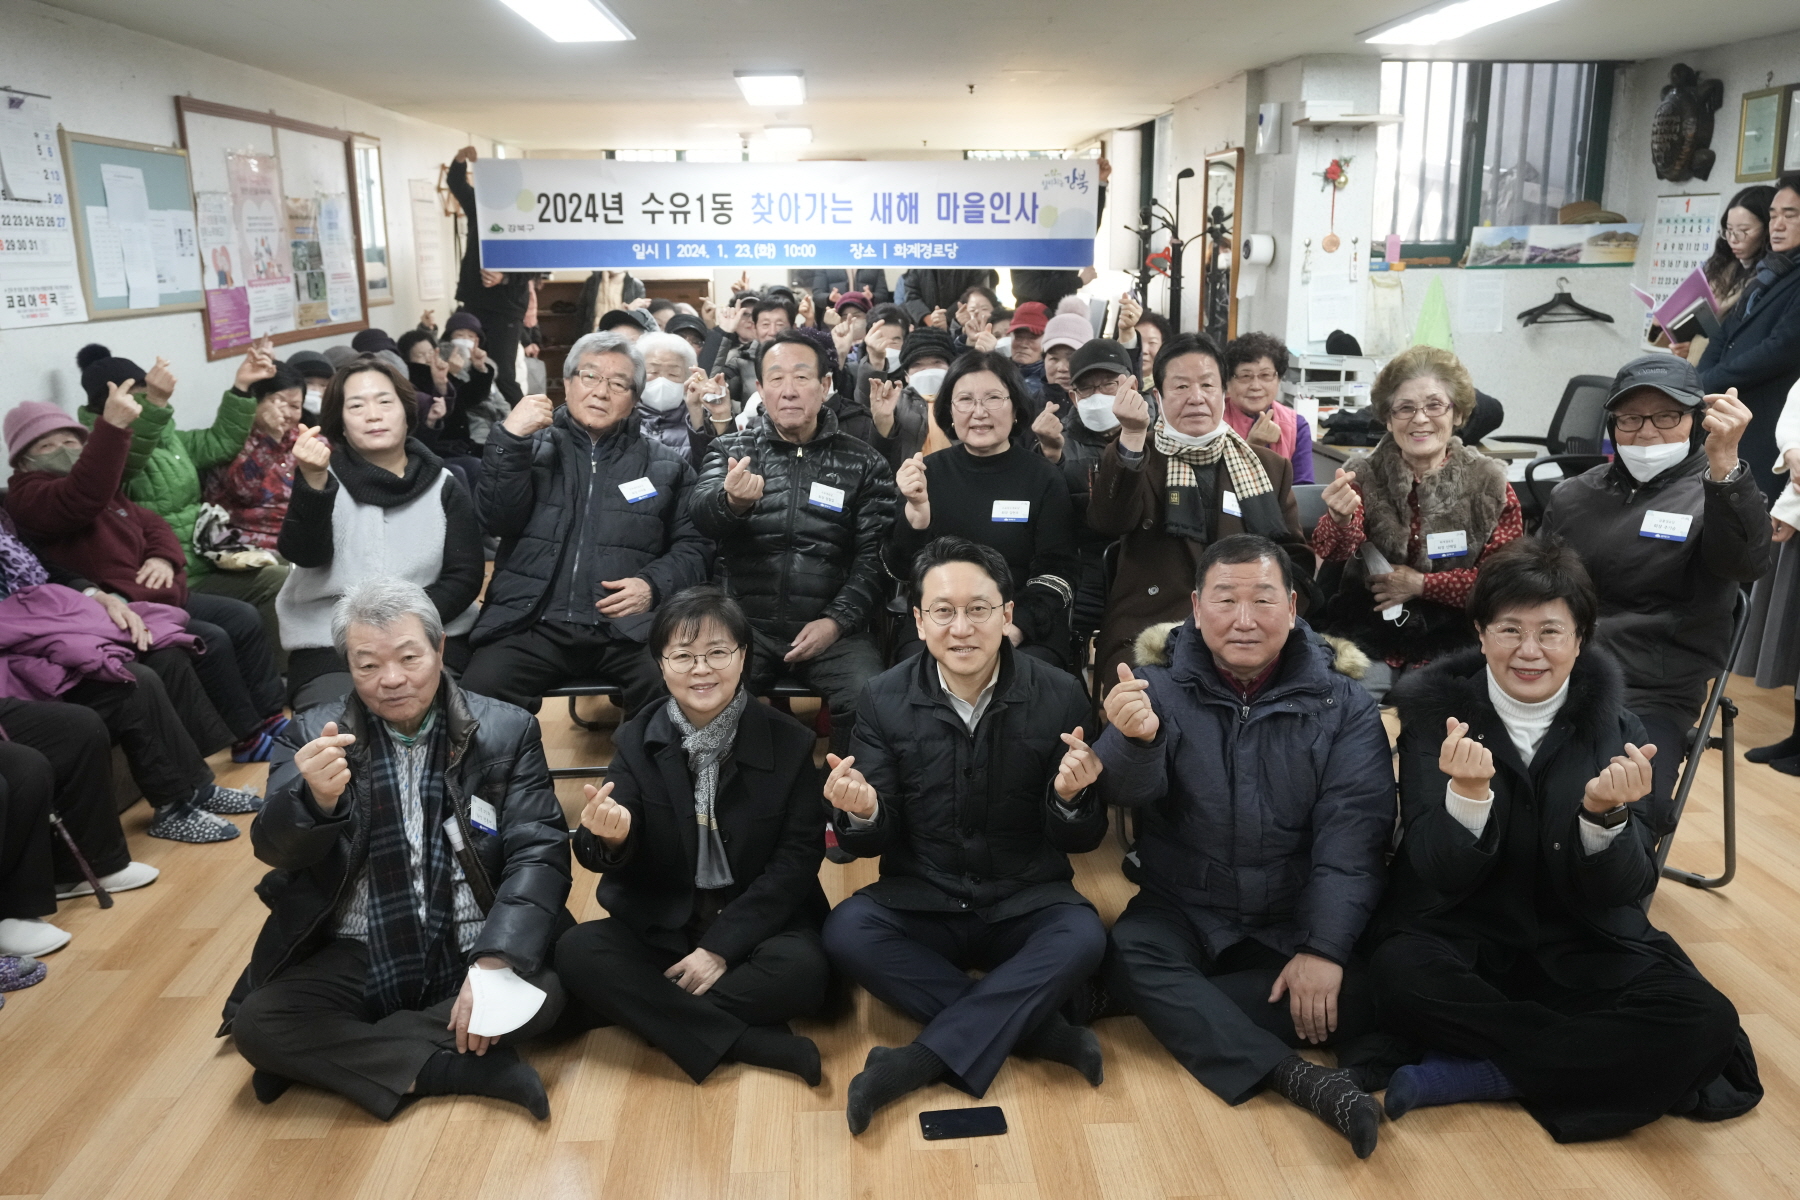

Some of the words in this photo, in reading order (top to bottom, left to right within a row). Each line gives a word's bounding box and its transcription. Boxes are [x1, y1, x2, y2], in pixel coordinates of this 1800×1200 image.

[1064, 168, 1089, 194] 강북
[537, 192, 624, 224] 2024년
[641, 192, 733, 225] 수유1동
[751, 191, 853, 224] 찾아가는
[870, 192, 919, 225] 새해
[937, 192, 1039, 225] 마을인사
[1685, 198, 1691, 213] 1
[632, 243, 659, 260] 일시
[677, 244, 710, 258] 2024.
[718, 244, 728, 258] 1.
[735, 244, 776, 260] 23.(화)
[783, 243, 816, 258] 10:00
[850, 243, 877, 259] 장소
[893, 243, 958, 259] 화계경로당
[6, 292, 58, 309] 코리아약국
